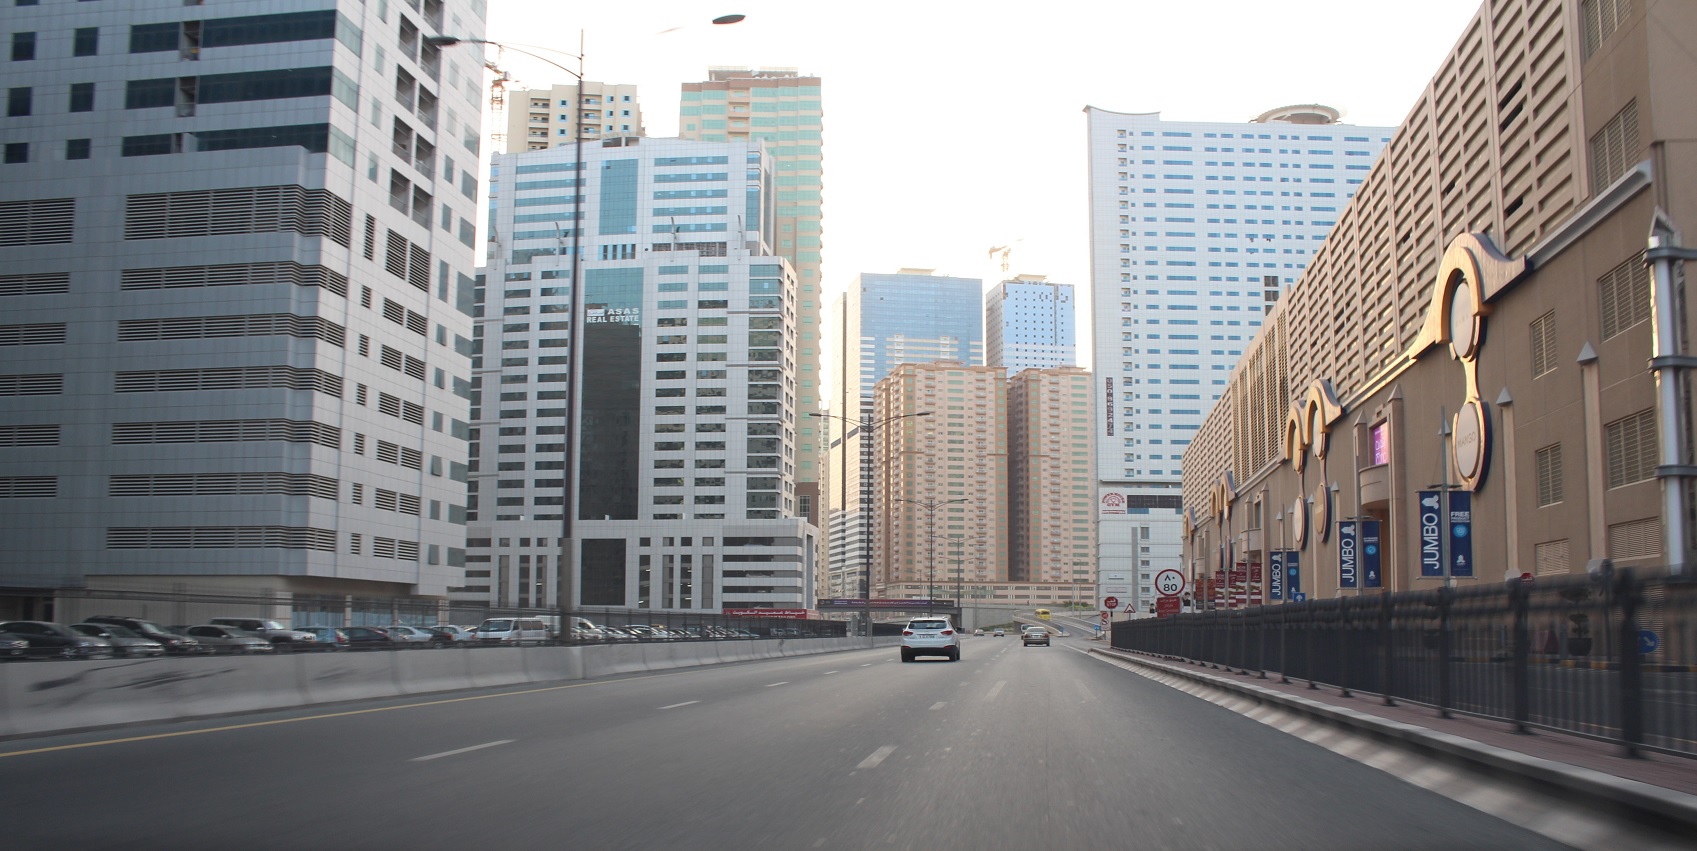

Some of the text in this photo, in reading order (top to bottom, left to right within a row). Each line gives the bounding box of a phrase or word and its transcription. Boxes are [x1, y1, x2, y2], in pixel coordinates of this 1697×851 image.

[1457, 431, 1476, 449] MANGO
[1422, 513, 1439, 569] JUMBO
[1341, 538, 1354, 583] JUMBO
[1163, 583, 1178, 592] 80
[1271, 563, 1281, 596] JUMBO
